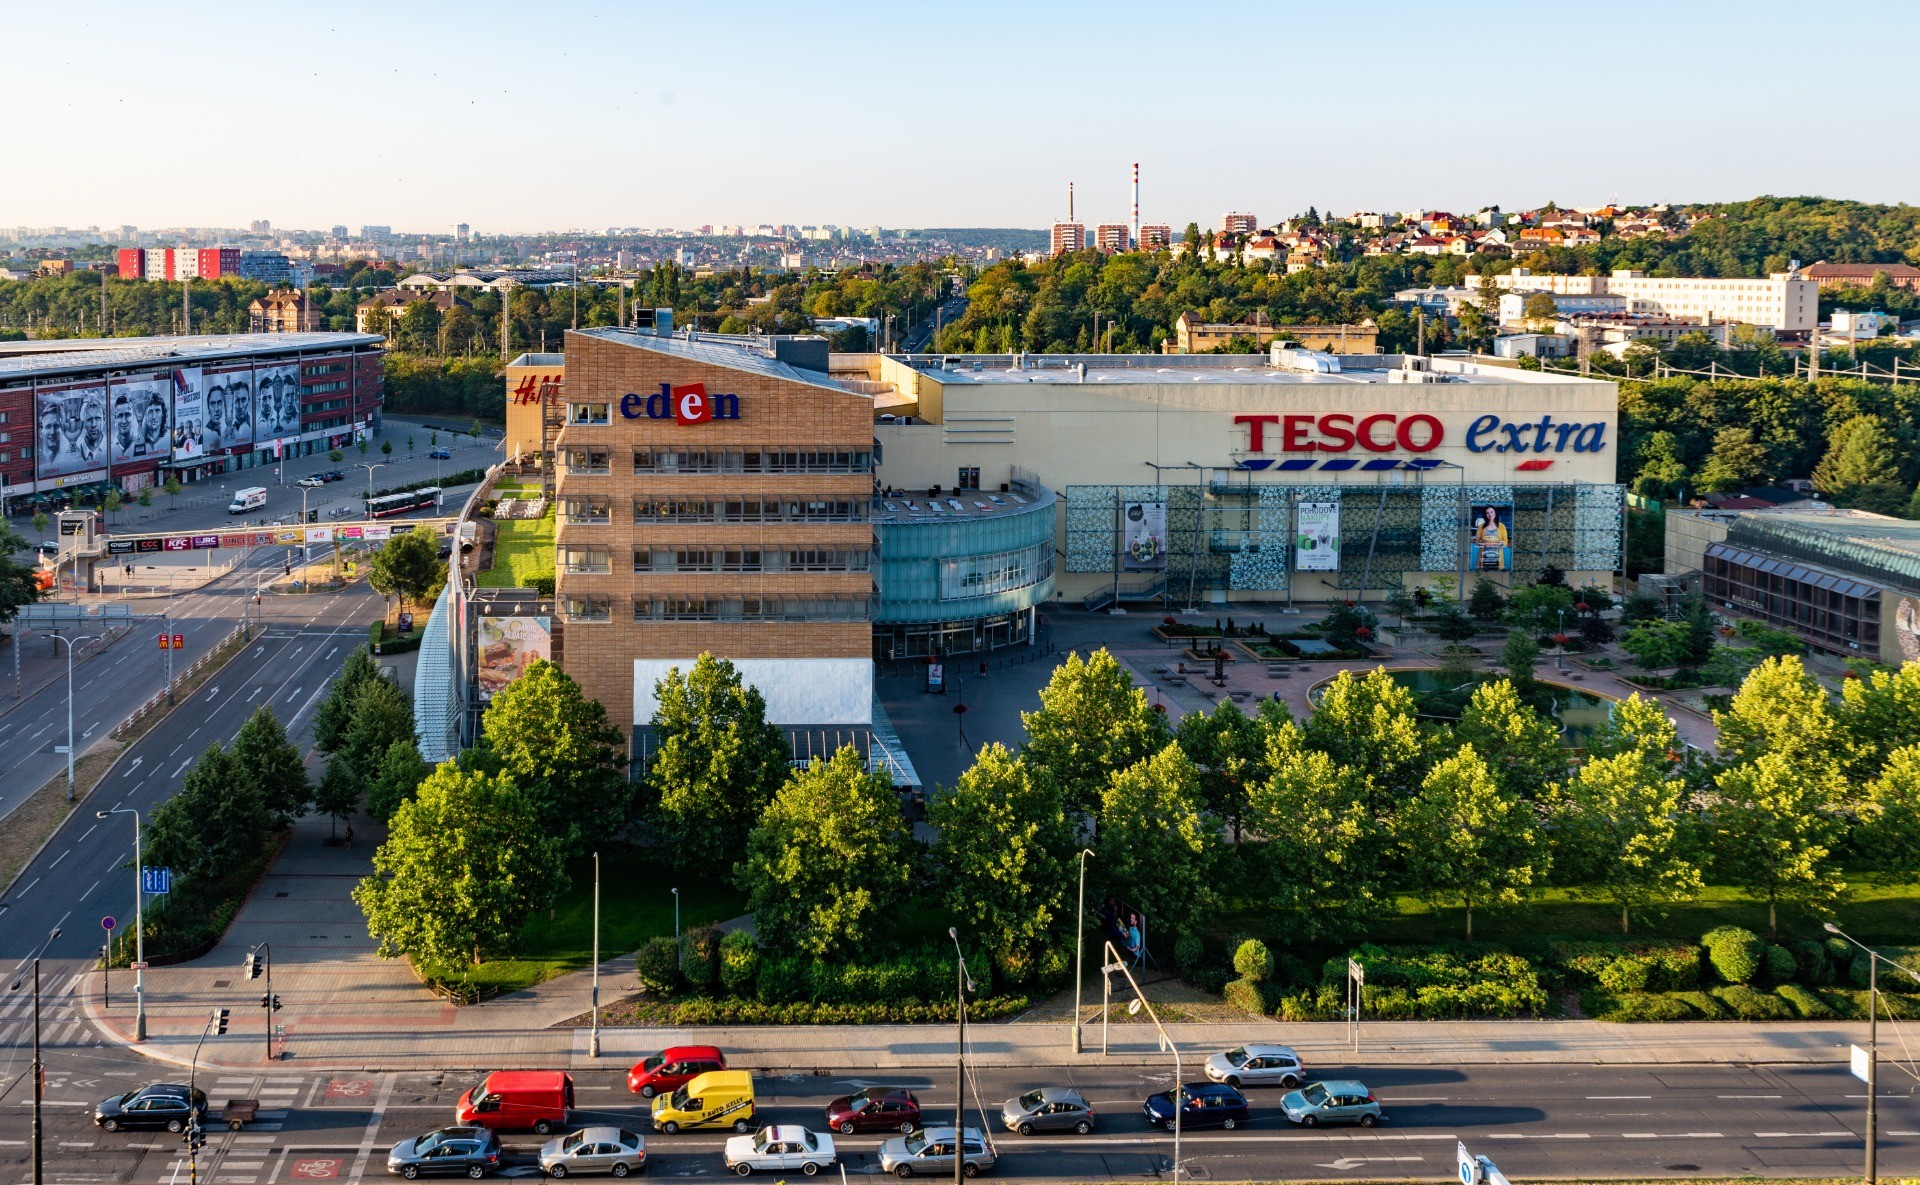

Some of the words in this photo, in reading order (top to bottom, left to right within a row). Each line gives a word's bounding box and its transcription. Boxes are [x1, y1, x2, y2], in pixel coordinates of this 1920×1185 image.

[513, 375, 562, 406] H&M
[620, 383, 741, 420] eden
[1234, 413, 1445, 453] TESCO
[1465, 414, 1607, 453] extra
[168, 539, 188, 547] KFC
[201, 536, 217, 544] JRC
[225, 537, 252, 545] UNCLE
[707, 1105, 724, 1117] AUTO
[726, 1097, 744, 1109] KELLY
